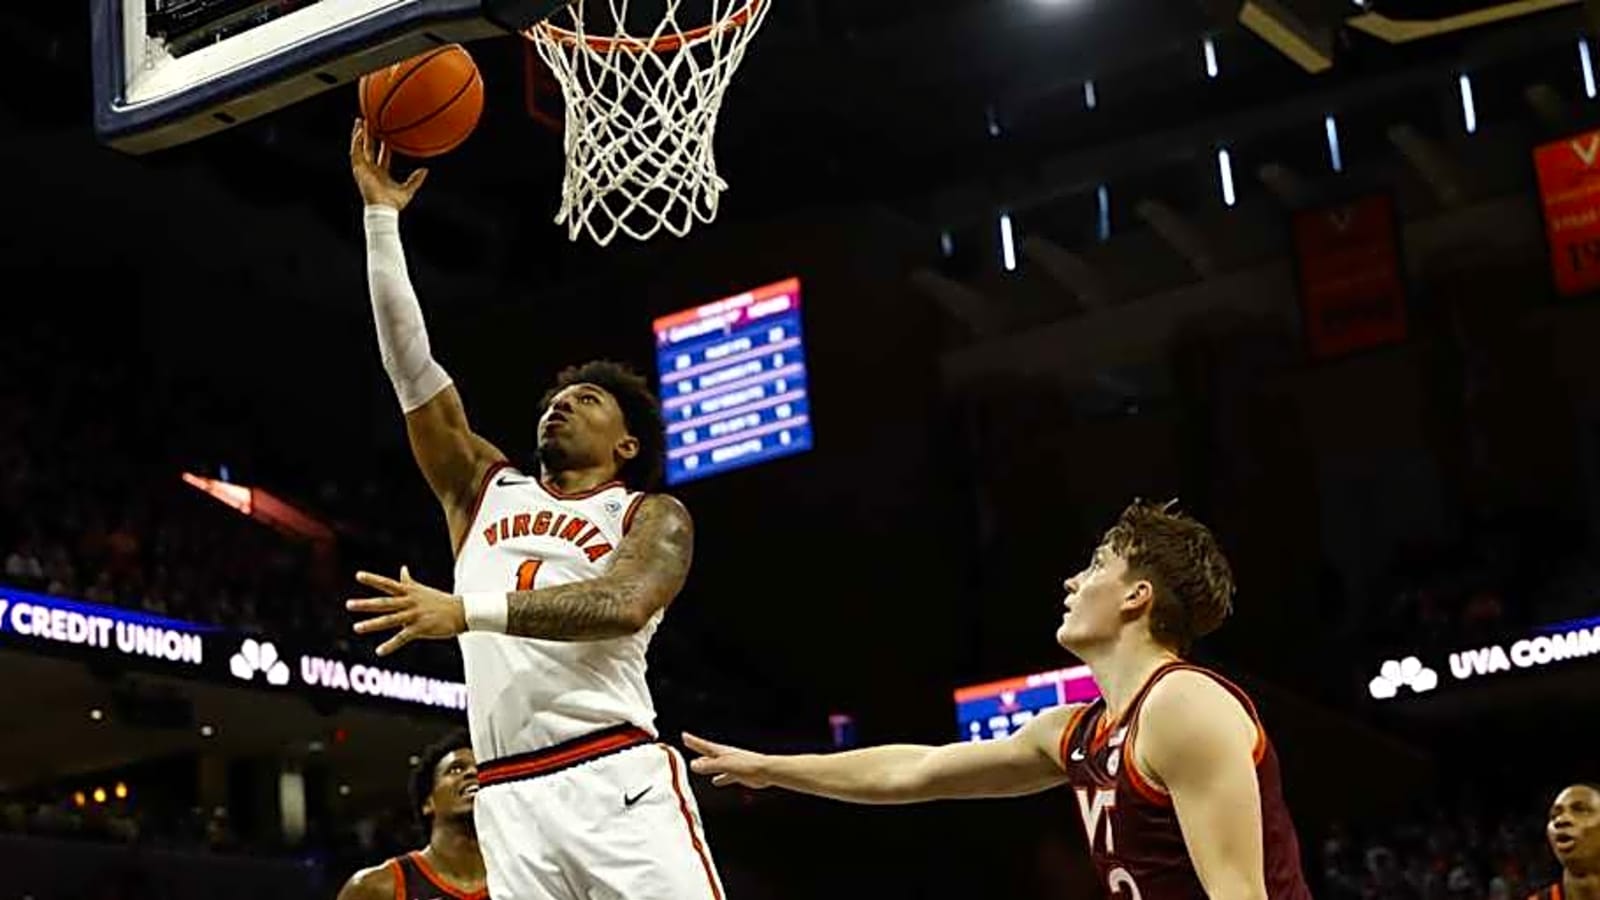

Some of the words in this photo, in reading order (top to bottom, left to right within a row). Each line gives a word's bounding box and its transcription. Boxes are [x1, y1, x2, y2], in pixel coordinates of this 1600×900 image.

[483, 510, 613, 564] VIRGINIA
[515, 559, 543, 592] 1
[11, 602, 114, 648] CREDIT
[116, 620, 202, 664] UNION
[301, 655, 350, 690] UVA
[1450, 645, 1510, 679] UVA
[1075, 789, 1116, 856] VT
